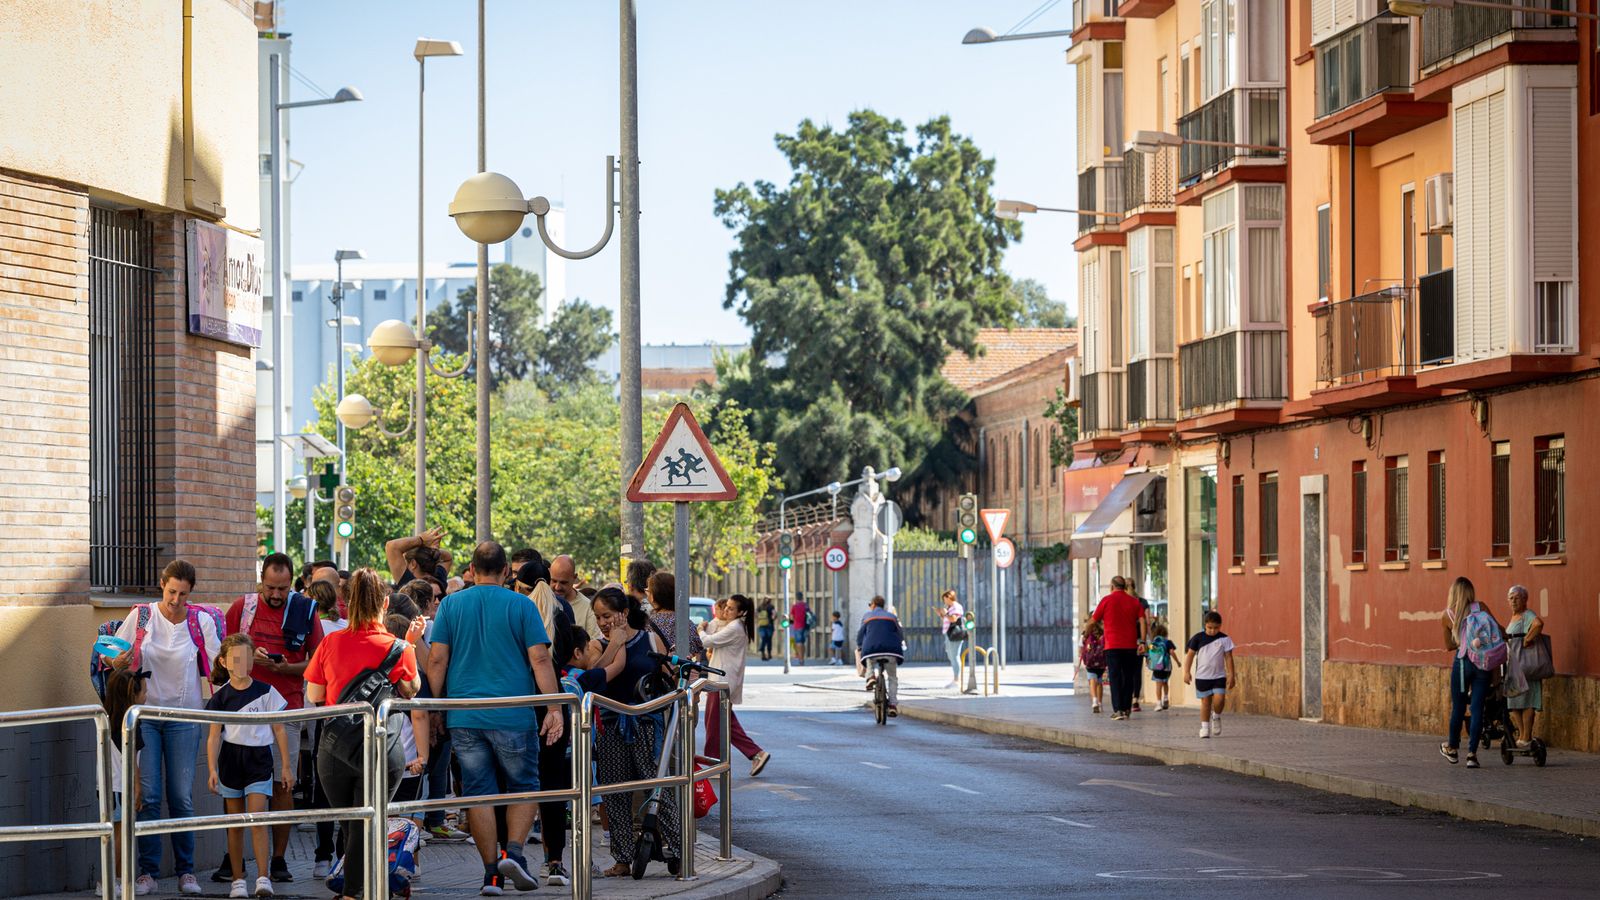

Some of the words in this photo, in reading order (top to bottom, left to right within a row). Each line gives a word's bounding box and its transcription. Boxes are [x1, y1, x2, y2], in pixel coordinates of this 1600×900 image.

[223, 246, 244, 290] Amor
[247, 252, 262, 296] Dios
[829, 554, 843, 563] 30
